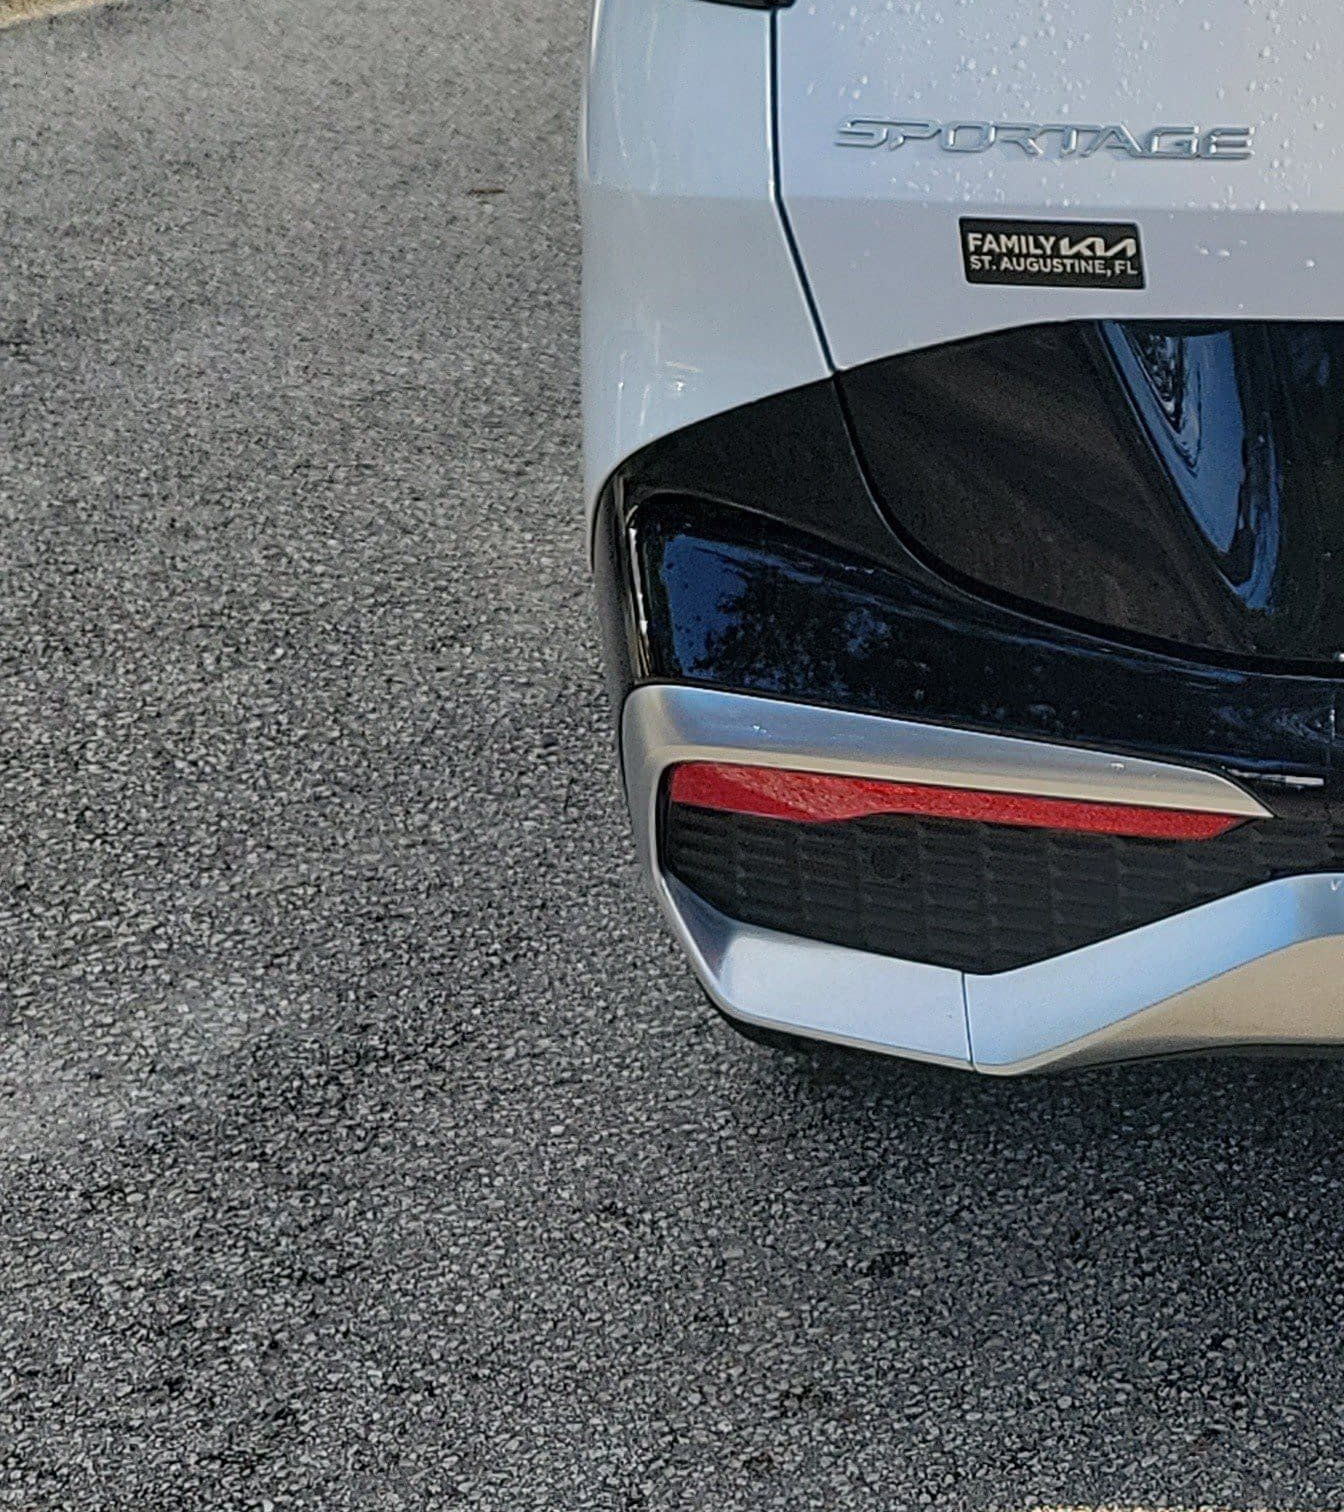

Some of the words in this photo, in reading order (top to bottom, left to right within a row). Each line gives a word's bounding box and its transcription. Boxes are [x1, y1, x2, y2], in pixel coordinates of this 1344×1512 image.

[834, 116, 1256, 160] SPORTAGE
[967, 232, 1055, 255] FAMILY
[1059, 236, 1137, 257] KIA
[969, 255, 997, 270] ST.
[1001, 256, 1111, 277] AUGUSTINE,
[1114, 260, 1138, 275] FL
